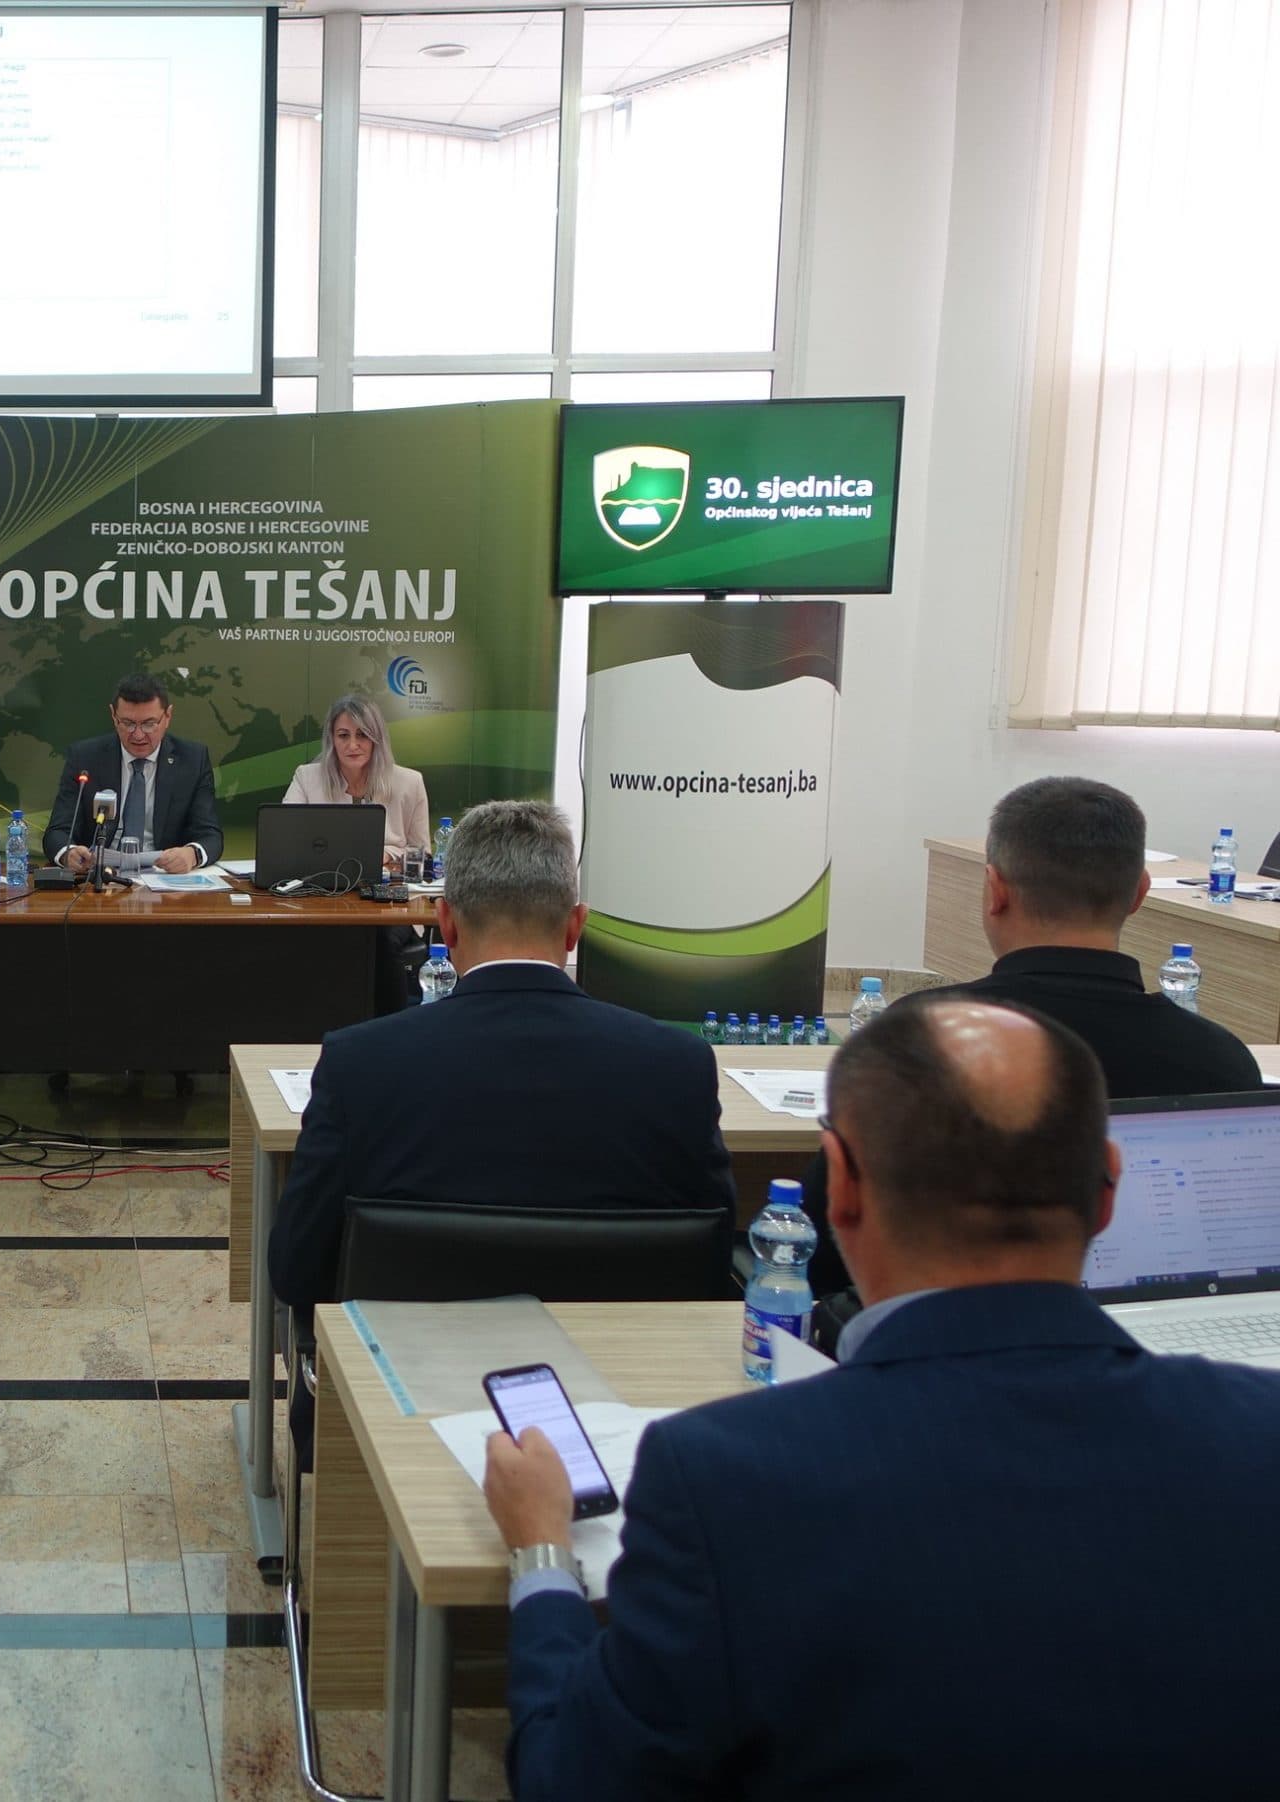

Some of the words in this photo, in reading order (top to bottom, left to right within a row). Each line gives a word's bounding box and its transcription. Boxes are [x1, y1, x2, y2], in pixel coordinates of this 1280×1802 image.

[705, 476, 749, 500] 30.
[756, 474, 873, 503] sjednica
[139, 502, 196, 515] BOSNA
[208, 500, 323, 515] HERCEGOVINA
[704, 504, 778, 521] Općinskog
[781, 504, 823, 519] vijeća
[826, 503, 872, 519] Tešanj
[91, 522, 188, 535] FEDERACIJA
[191, 521, 246, 535] BOSNE
[258, 520, 369, 534] HERCEGOVINE
[116, 539, 274, 555] ZENIČKO-DOBOJSKI
[277, 540, 345, 554] KANTON
[244, 559, 457, 621] TEŠANJ
[218, 626, 242, 641] VAŠ
[245, 629, 300, 641] PARTNER
[303, 629, 313, 641] U
[315, 627, 410, 643] JUGOISTOČNOJ
[413, 630, 455, 643] EUROPI
[610, 769, 817, 799] www.opcina-tesanj.ba
